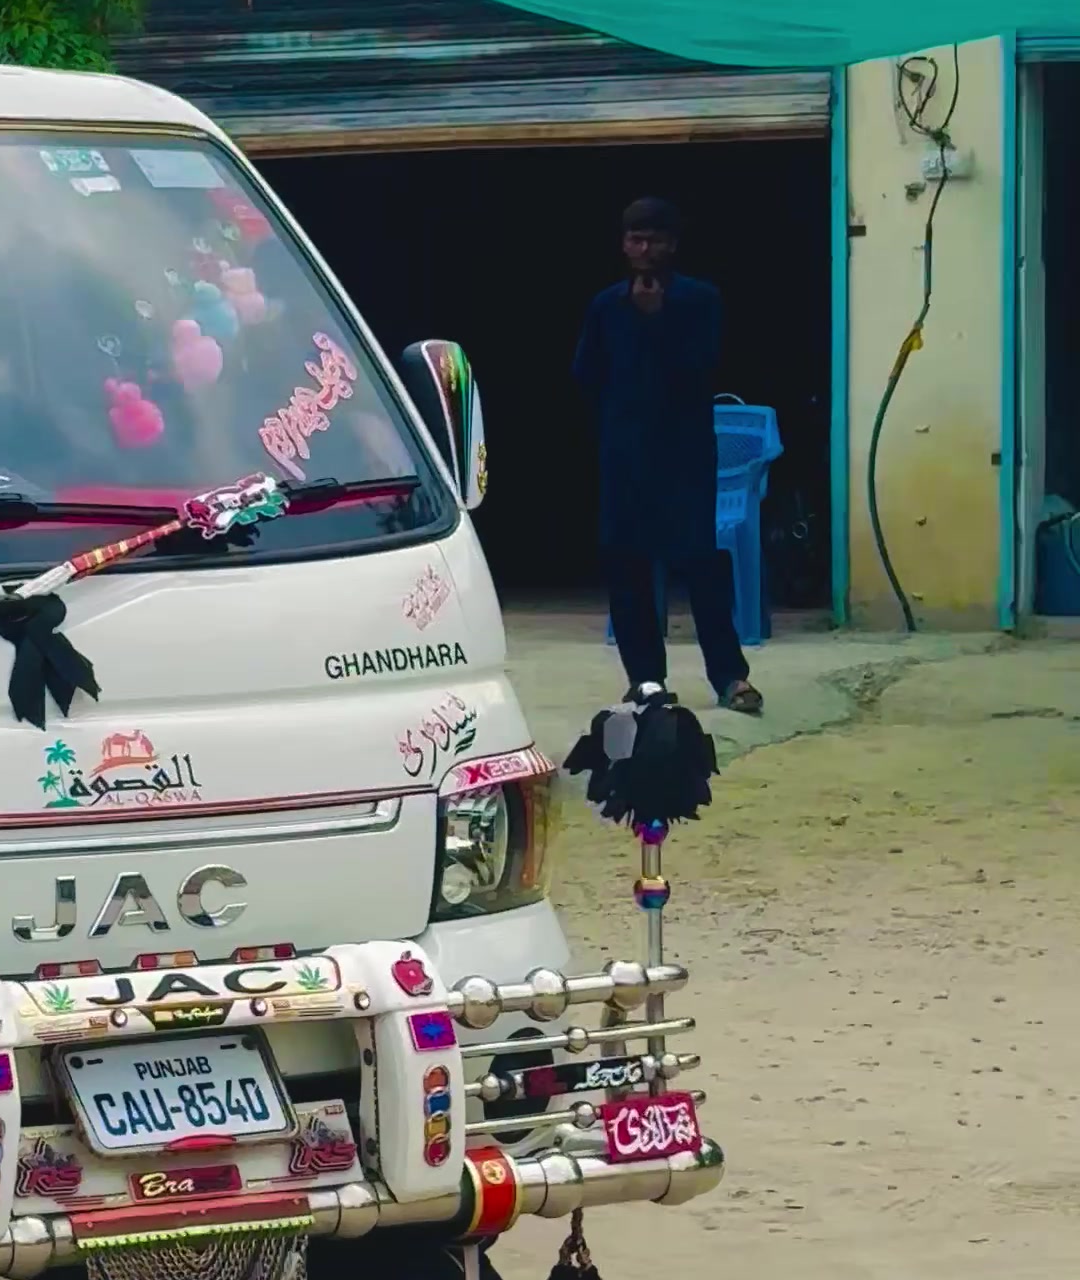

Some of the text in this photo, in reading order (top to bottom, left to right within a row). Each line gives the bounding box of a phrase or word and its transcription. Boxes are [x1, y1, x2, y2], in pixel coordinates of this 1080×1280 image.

[324, 642, 468, 679] GHANDHARA
[104, 788, 203, 808] AL-QASWA
[12, 863, 248, 943] JAC
[86, 966, 287, 1005] JAC
[134, 1055, 212, 1081] PUNJAB
[93, 1077, 270, 1137] CAU-8540
